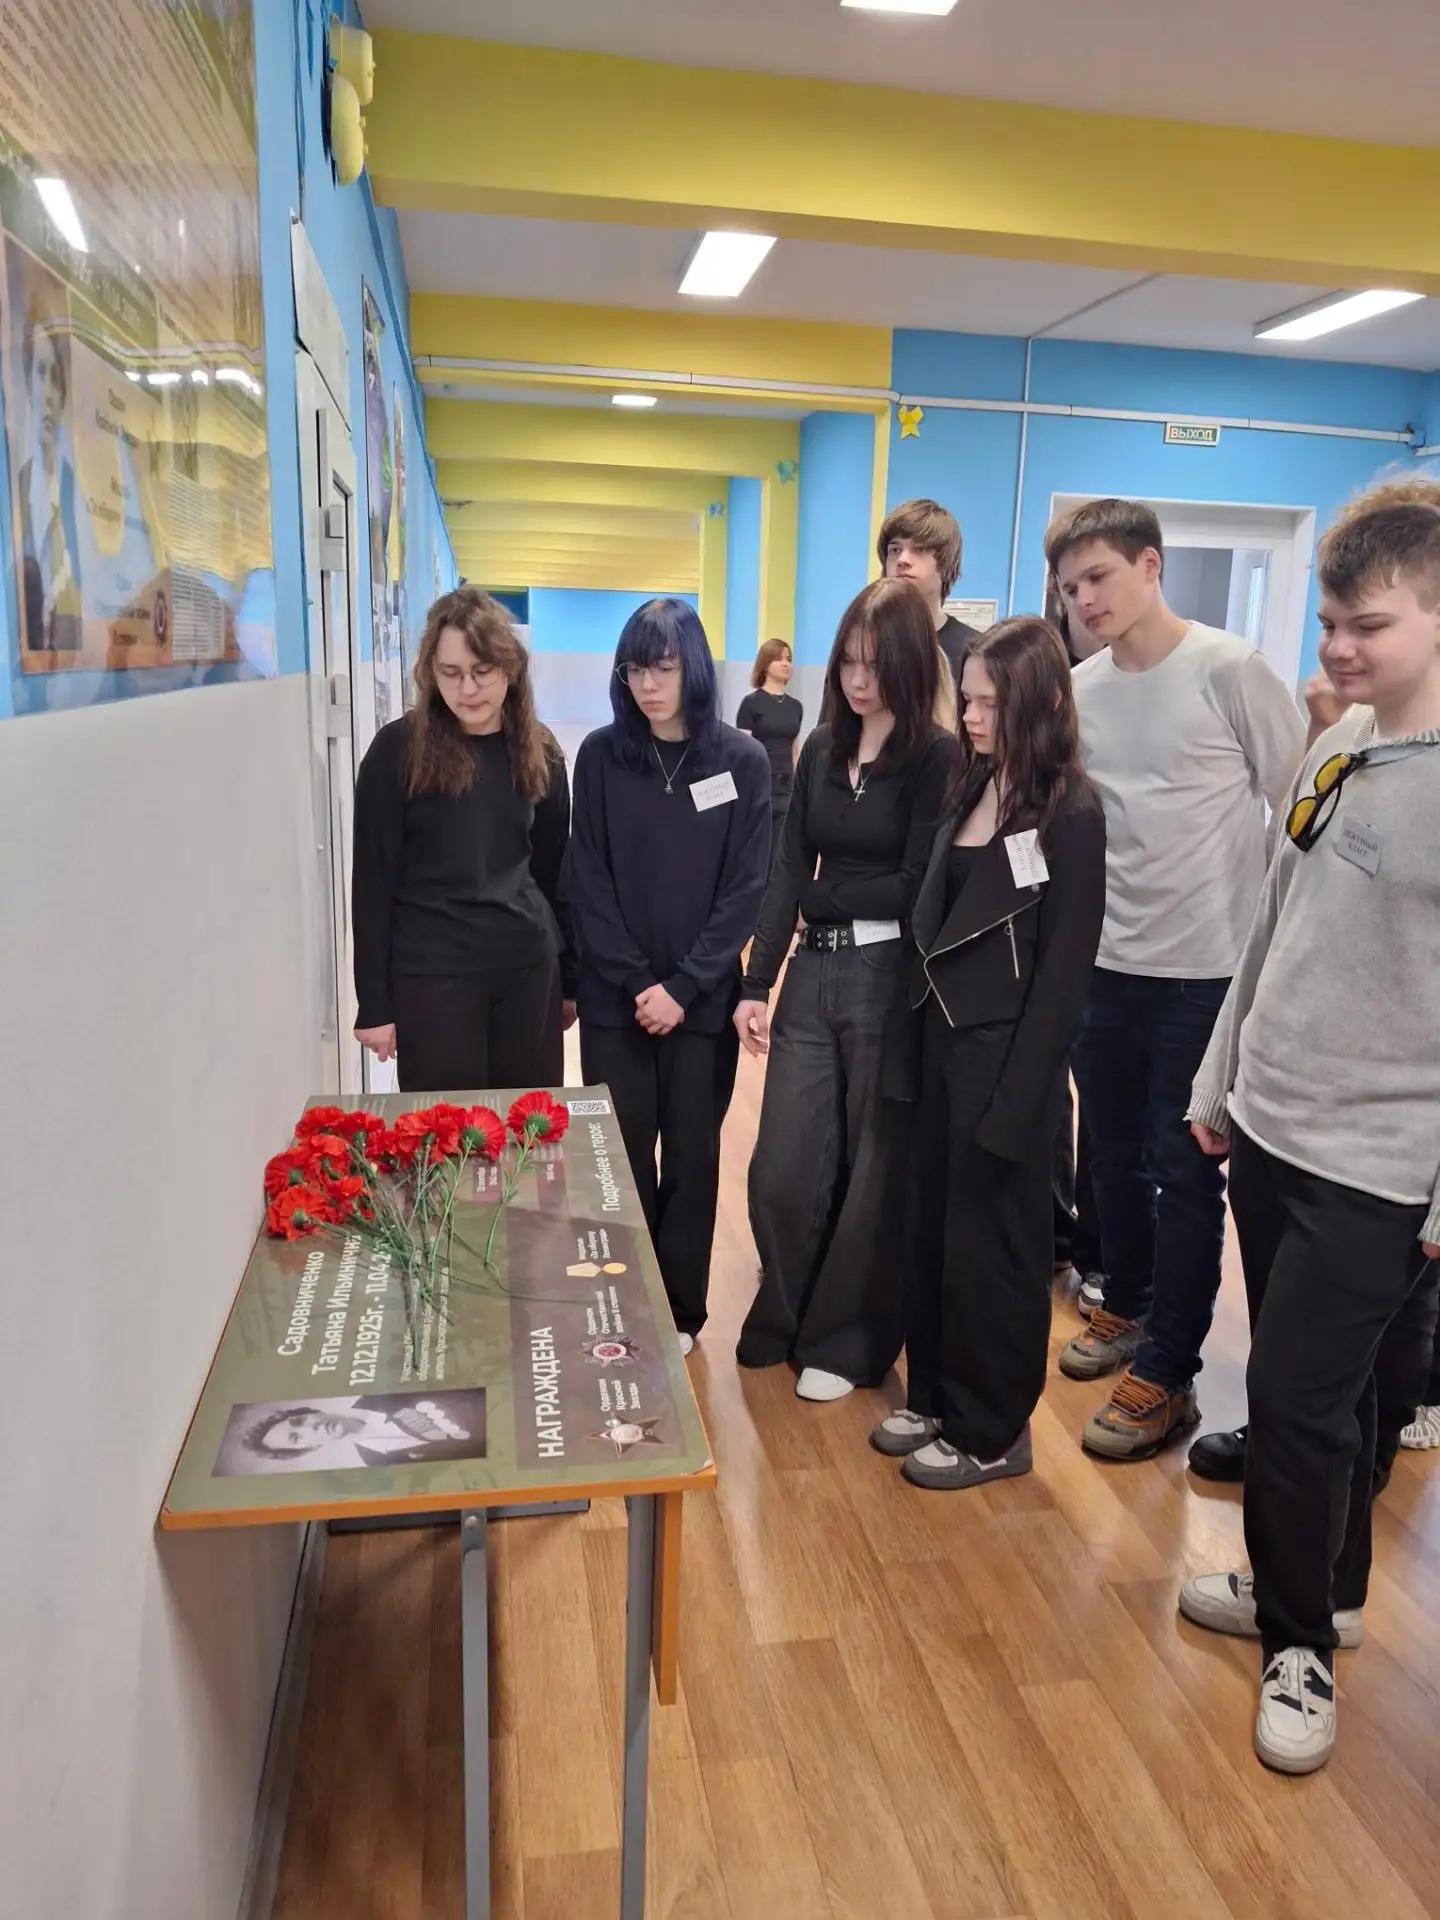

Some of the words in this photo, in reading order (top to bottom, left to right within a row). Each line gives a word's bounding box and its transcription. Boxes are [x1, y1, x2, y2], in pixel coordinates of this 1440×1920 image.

[1170, 427, 1213, 441] ВЫХОД
[589, 1122, 607, 1148] герое:
[594, 1156, 620, 1211] Подробнее
[277, 1251, 324, 1355] Садовниченко
[311, 1311, 347, 1376] Татьяна
[349, 1304, 385, 1386] 12.12.1925г.
[530, 1326, 565, 1457] НАГРАЖДЕНА
[611, 1379, 627, 1411] Красной
